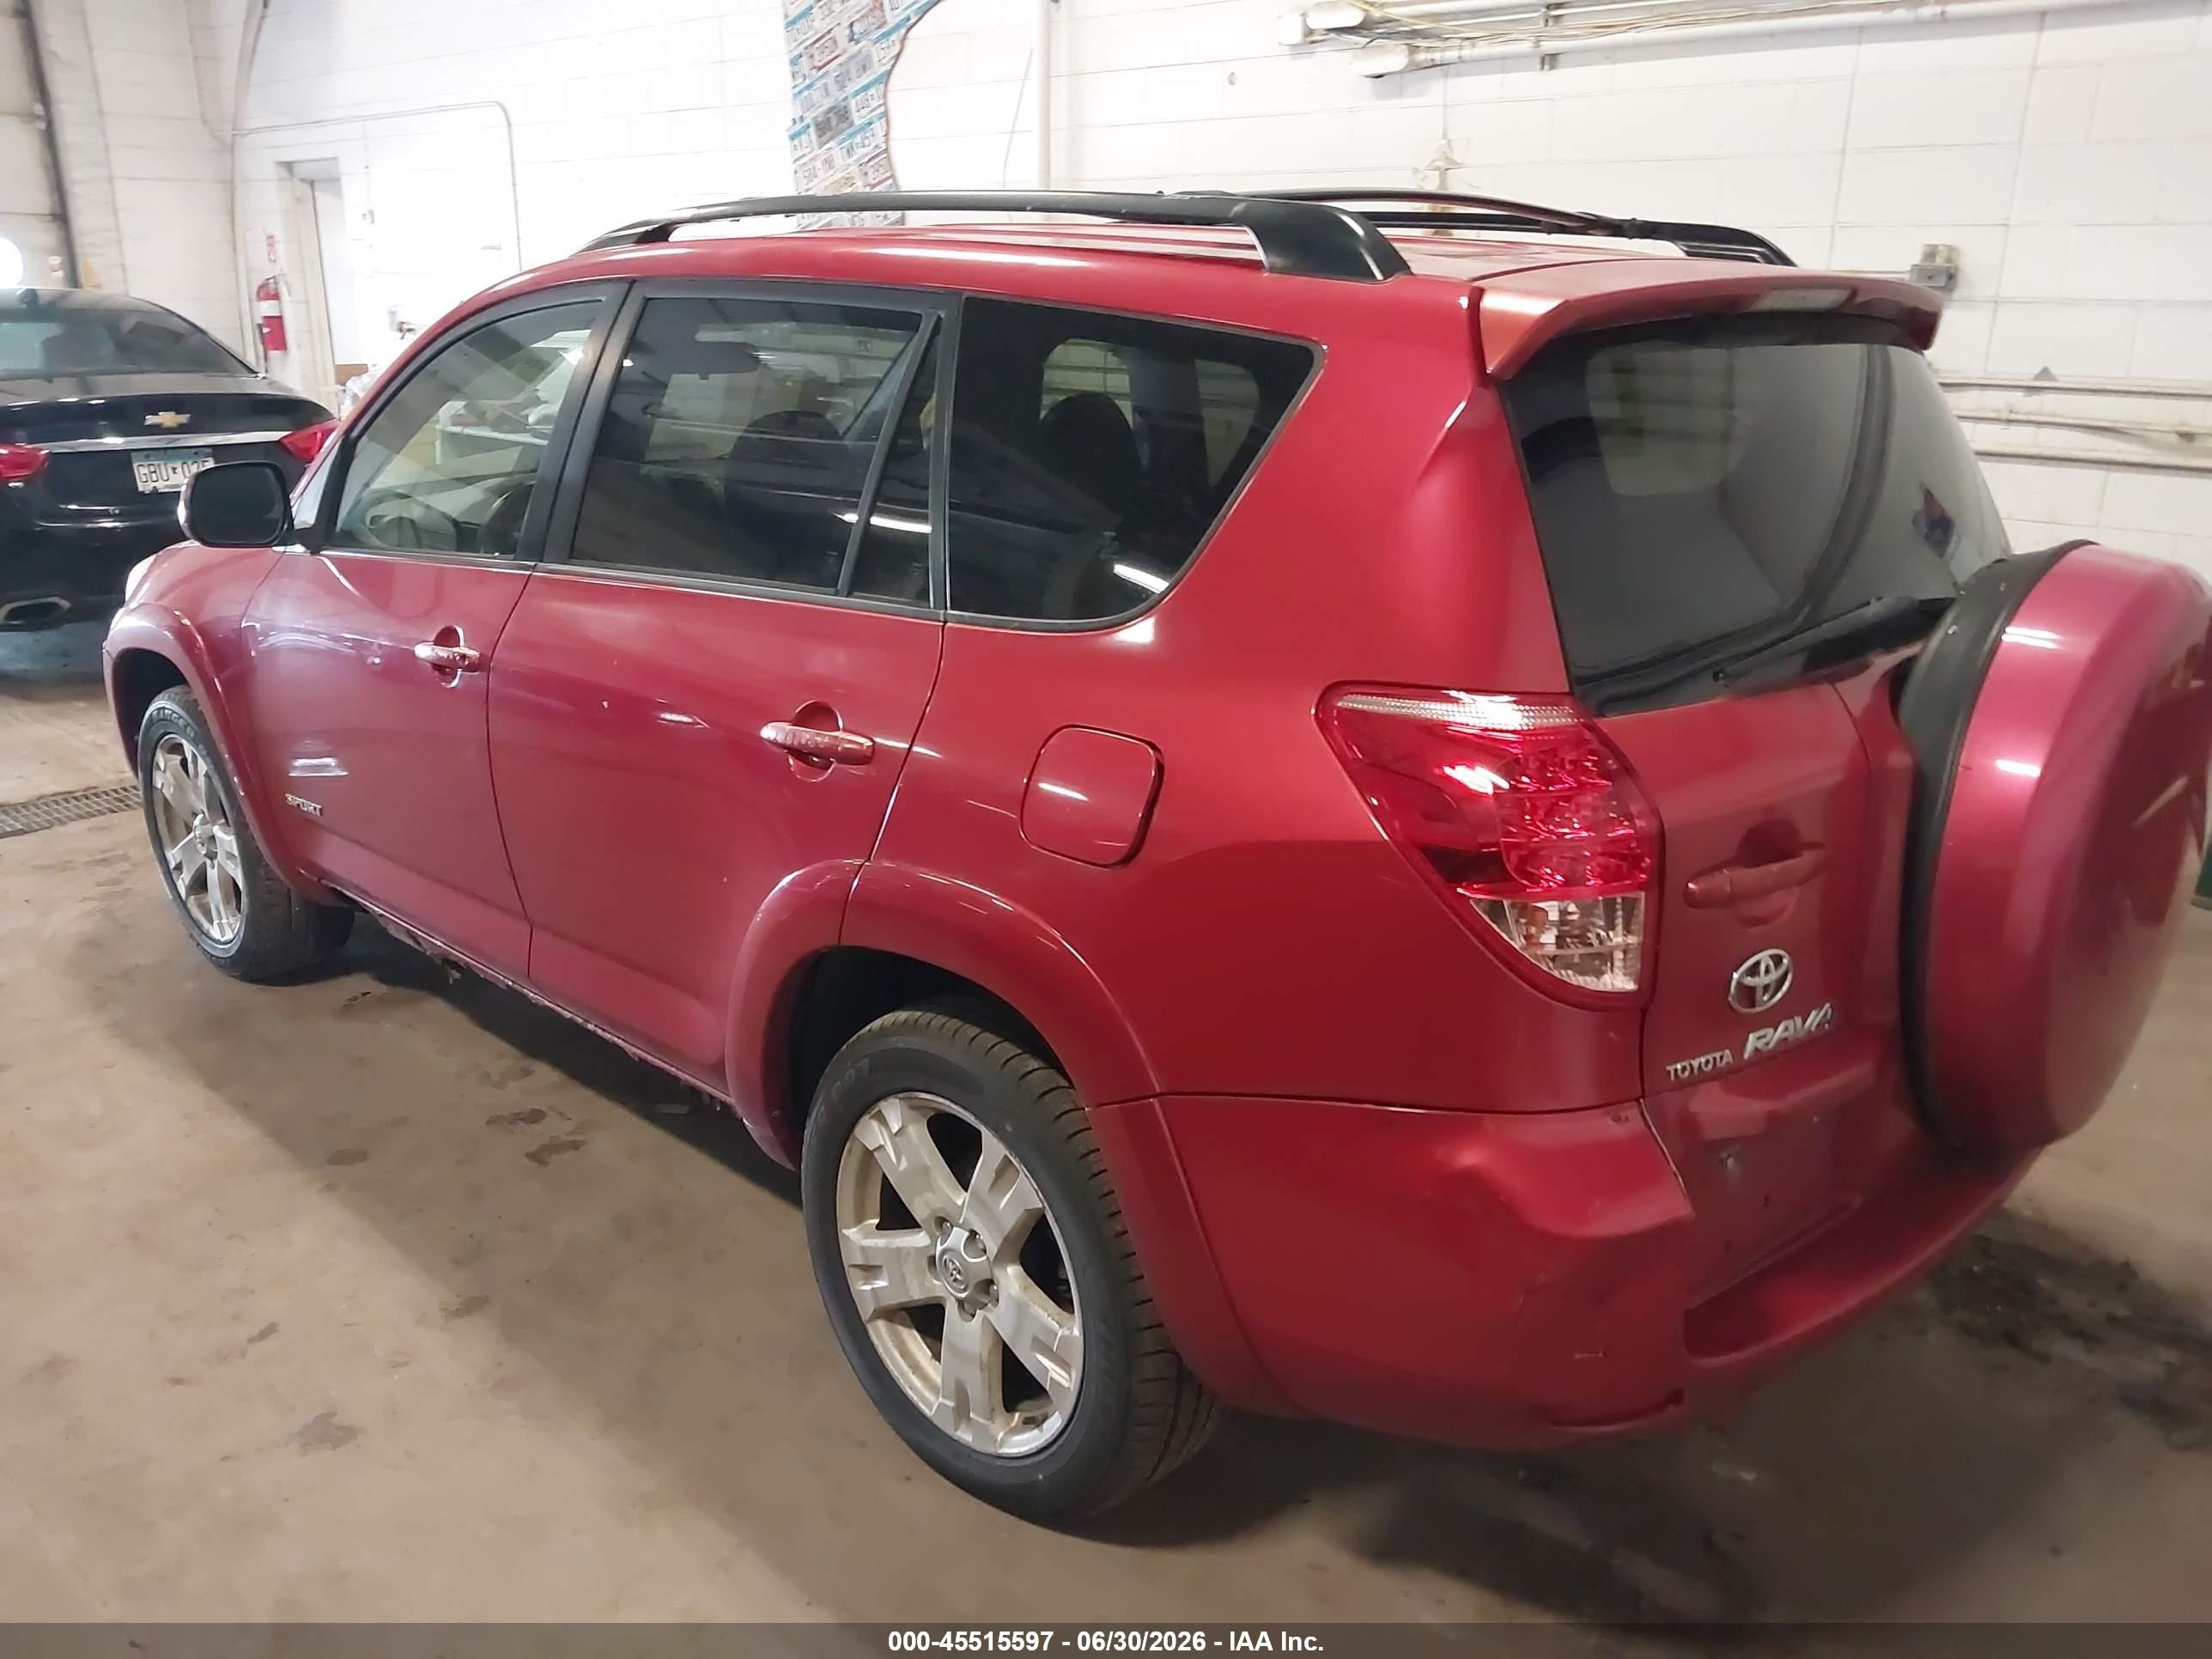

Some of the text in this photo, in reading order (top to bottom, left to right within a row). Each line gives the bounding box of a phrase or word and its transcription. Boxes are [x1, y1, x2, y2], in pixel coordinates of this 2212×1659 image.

[137, 463, 169, 483] GBU
[284, 793, 323, 817] SPORT
[1666, 1003, 1832, 1081] TOYOTA RAV4
